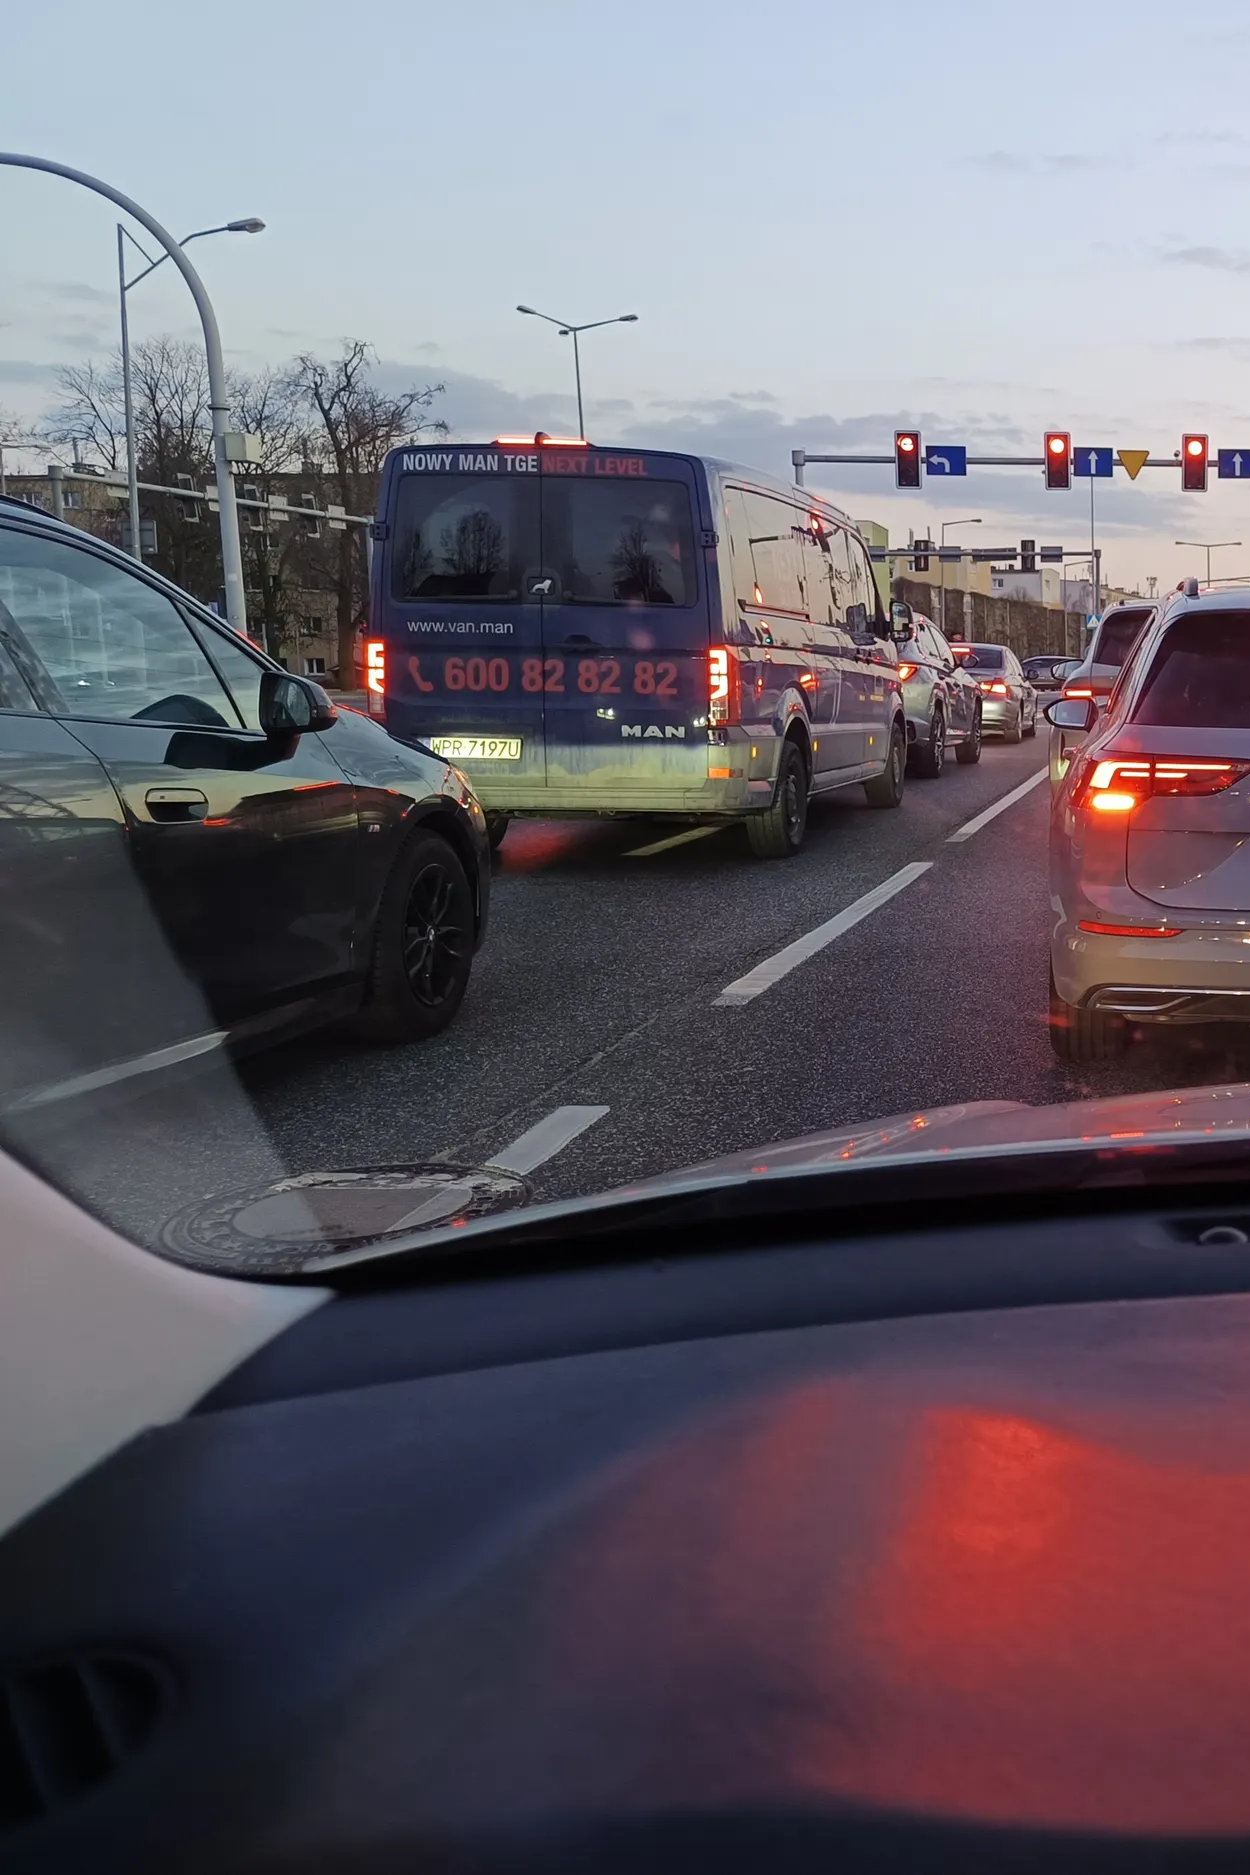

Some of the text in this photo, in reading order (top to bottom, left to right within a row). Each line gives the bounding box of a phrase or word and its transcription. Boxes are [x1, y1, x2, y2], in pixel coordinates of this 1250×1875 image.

[402, 453, 648, 476] NOWY MAN TGE NEXT LEVEL
[407, 621, 514, 635] www.van.man
[444, 658, 678, 695] 600 82 82 82
[621, 725, 686, 739] MAN
[432, 740, 519, 757] WPR 7197U
